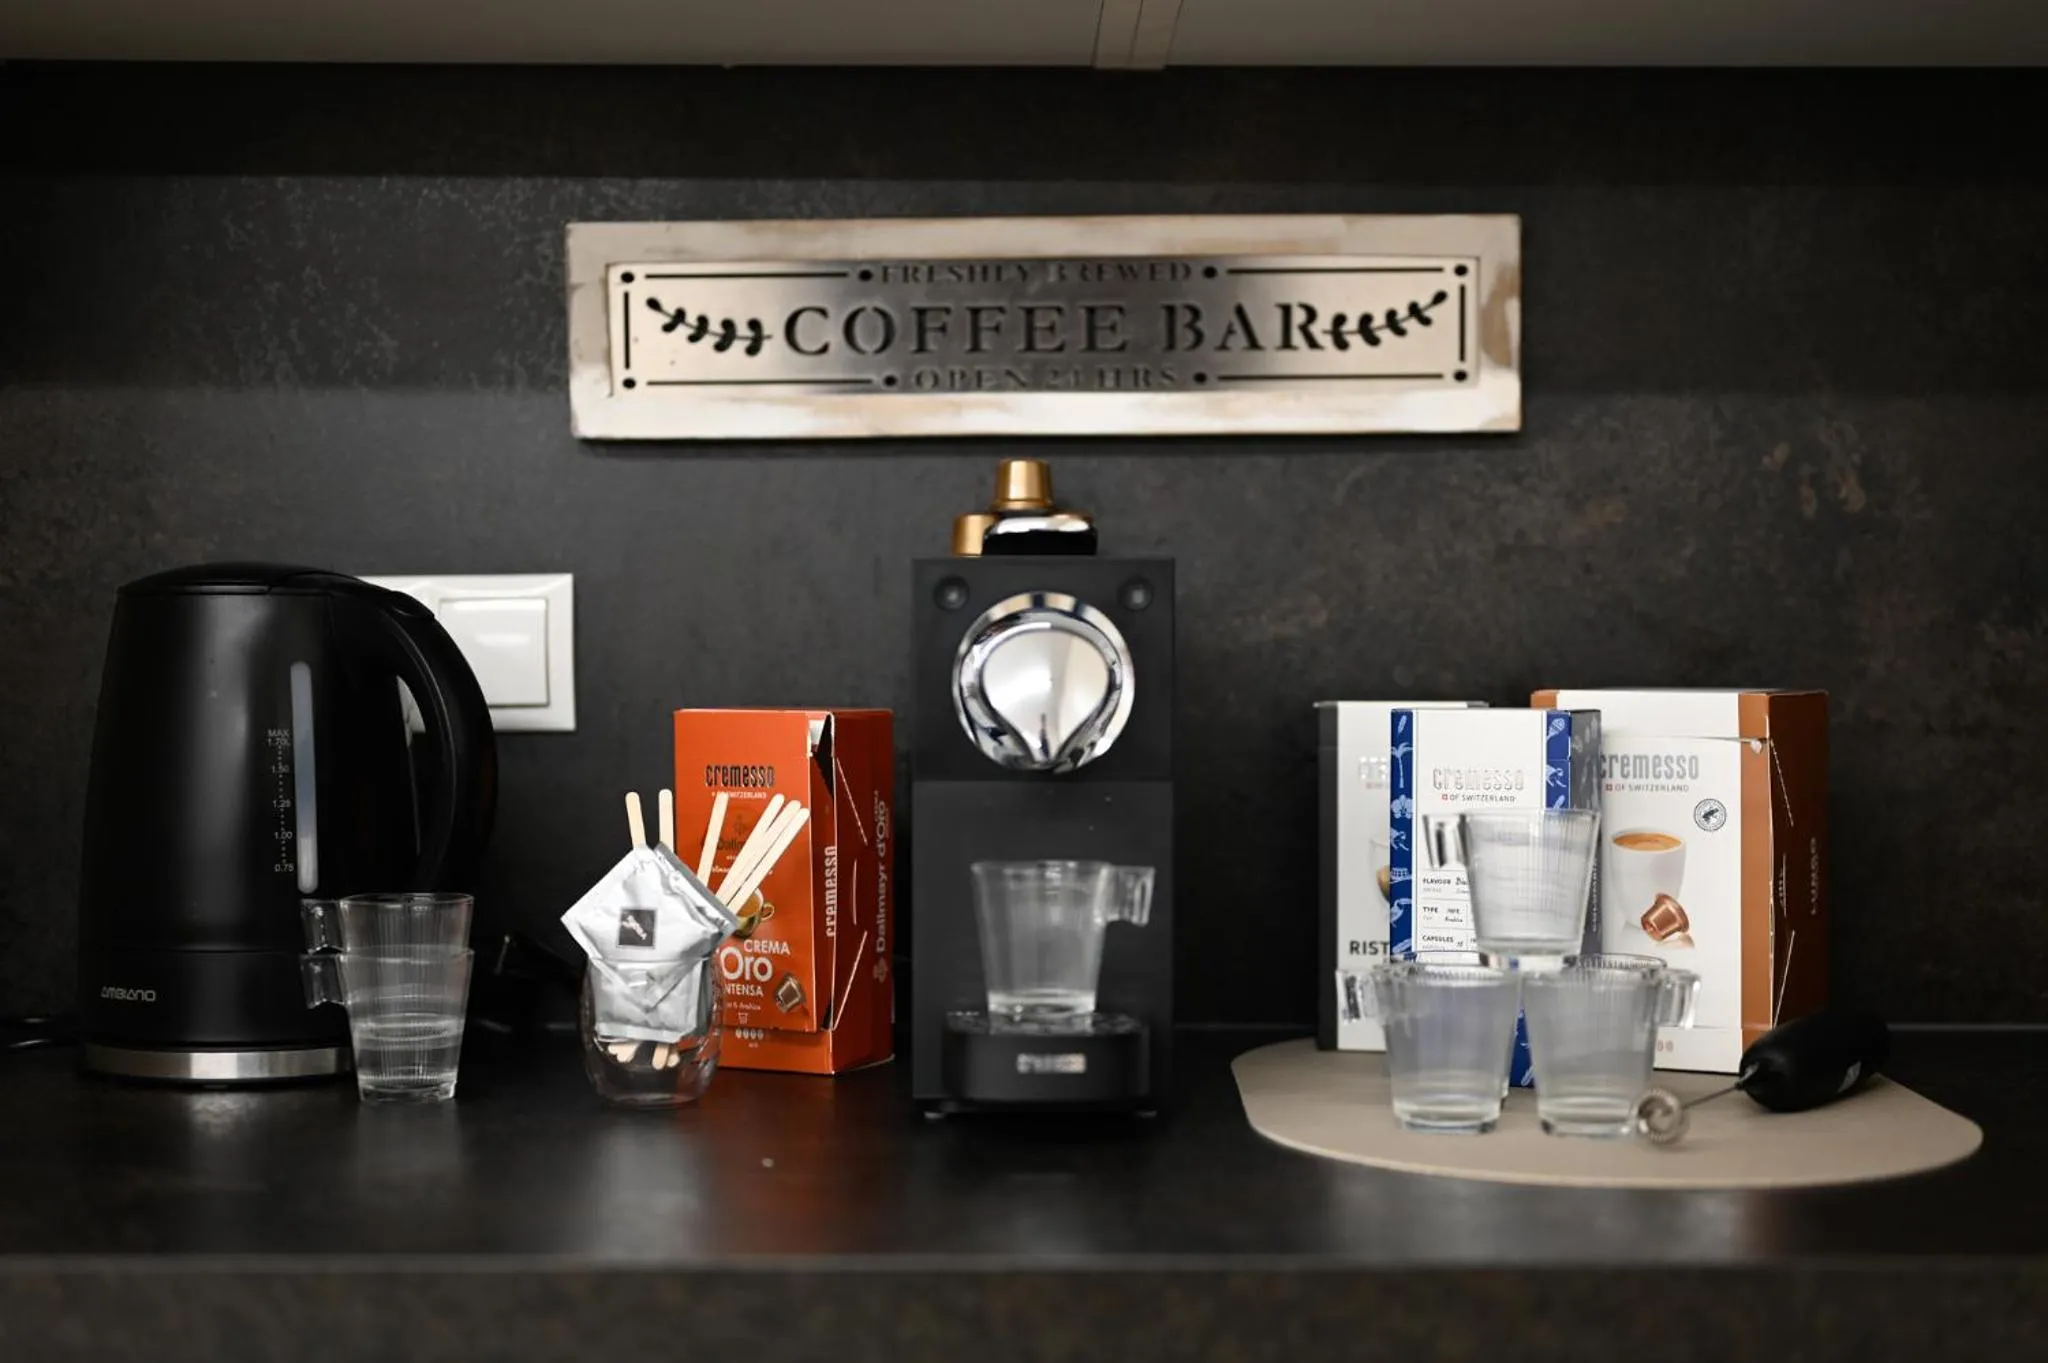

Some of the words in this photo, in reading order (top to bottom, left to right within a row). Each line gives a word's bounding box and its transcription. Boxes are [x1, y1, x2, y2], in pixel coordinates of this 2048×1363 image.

[882, 263, 1031, 285] FRESHLY
[1048, 262, 1193, 284] BREWED
[783, 304, 1129, 355] COFFEE
[1160, 302, 1325, 353] BAR
[914, 368, 1029, 390] OPEN
[1097, 366, 1178, 389] HRS
[267, 729, 290, 737] MAX
[1600, 753, 1700, 780] cremesso
[704, 764, 776, 788] cremesso
[1432, 767, 1524, 791] cremesso
[1614, 783, 1625, 792] OF
[1628, 783, 1690, 793] SWITZERLAND
[272, 800, 291, 808] 1.25
[1449, 793, 1460, 801] OF
[1461, 793, 1517, 803] SWITZERLAND
[274, 831, 293, 840] 1.00
[274, 864, 294, 872] 0.75
[824, 845, 837, 938] cremesso
[875, 862, 888, 953] Dallmayr
[1422, 906, 1439, 914] TYPE
[743, 938, 792, 956] CREMA
[1422, 934, 1455, 944] CAPSULES
[723, 982, 765, 998] NTENSA
